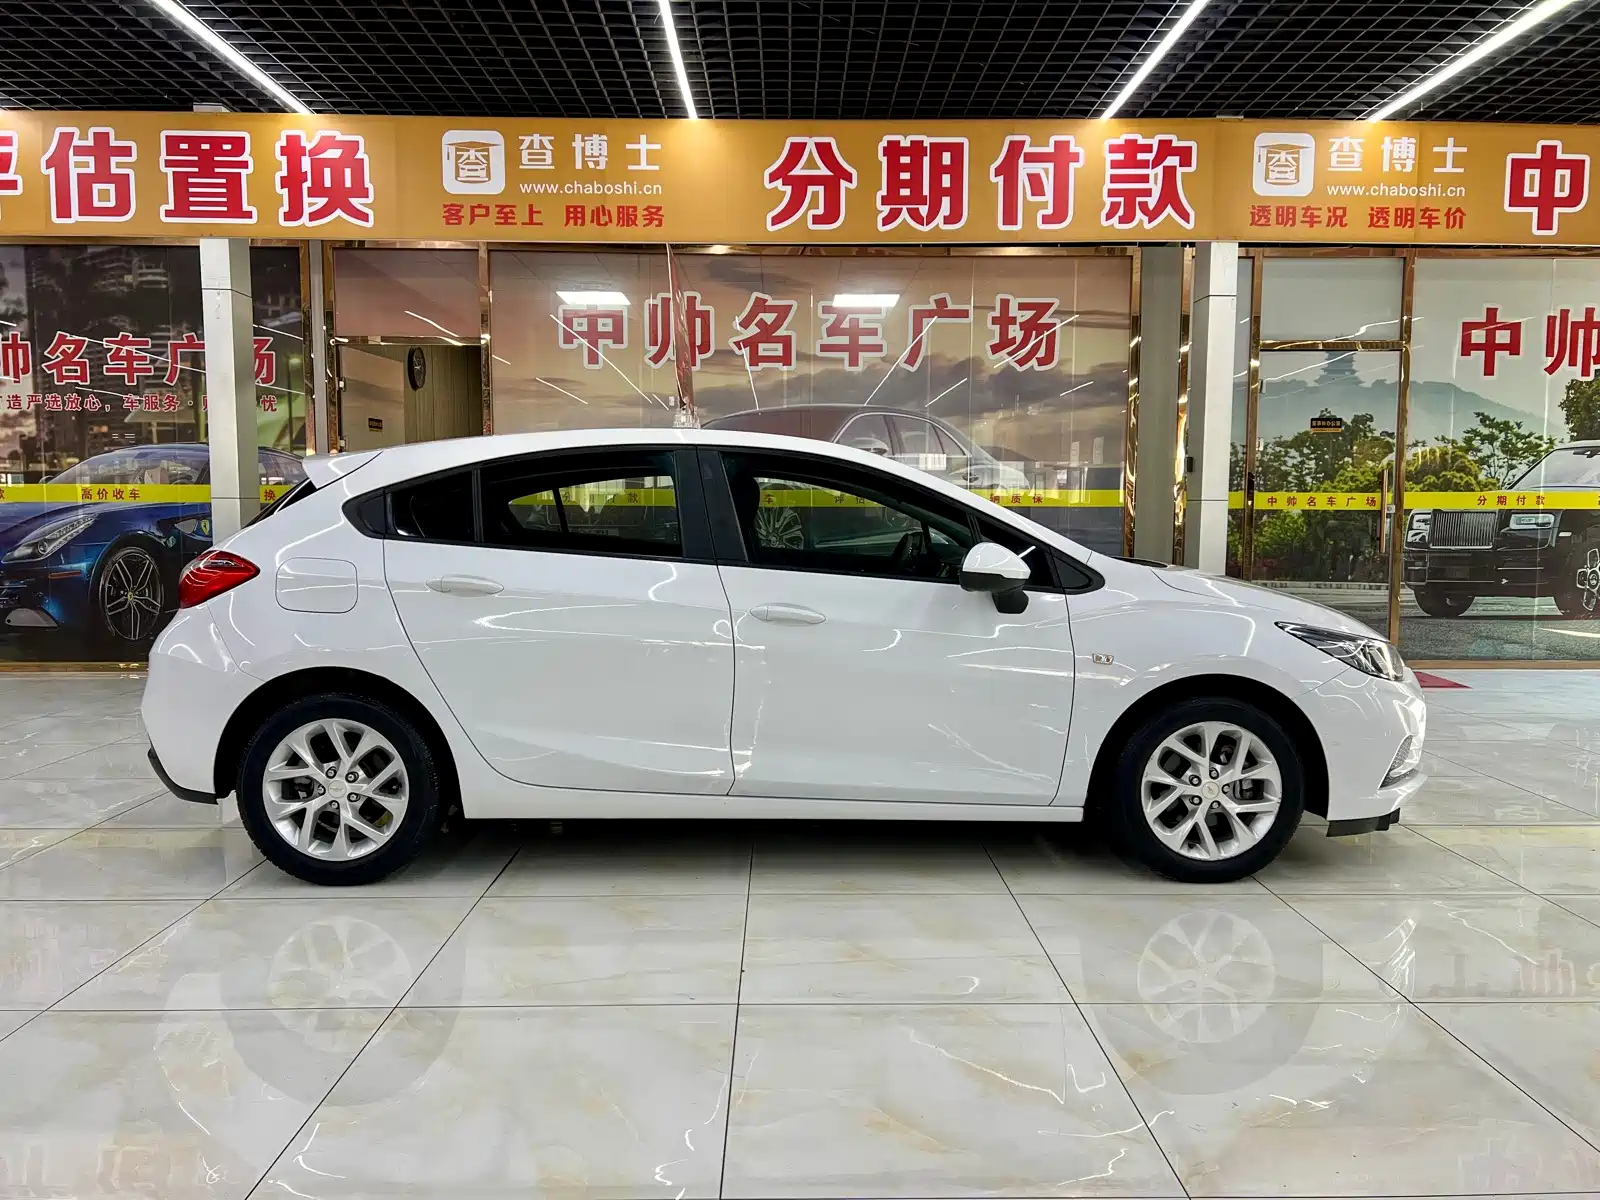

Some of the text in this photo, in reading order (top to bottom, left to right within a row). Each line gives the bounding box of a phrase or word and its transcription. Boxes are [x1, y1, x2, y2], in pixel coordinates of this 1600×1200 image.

[519, 134, 661, 170] 查博士
[1328, 137, 1467, 172] 查博士
[0, 127, 373, 226] 估置换
[519, 181, 662, 195] www.chaboshi.cn
[764, 134, 1197, 231] 分期付款
[1326, 183, 1466, 197] www.chaboshi.cn
[1504, 140, 1590, 235] 中
[442, 204, 665, 228] 客户至上 用心服务
[1250, 205, 1466, 229] 透明车况 透明车价
[557, 292, 1061, 371] 中帅名车广场
[1460, 306, 1600, 378] 中帅
[81, 488, 141, 501] 高价收车
[1267, 495, 1377, 507] 中帅名车广场
[1477, 495, 1545, 506] 分期付款
